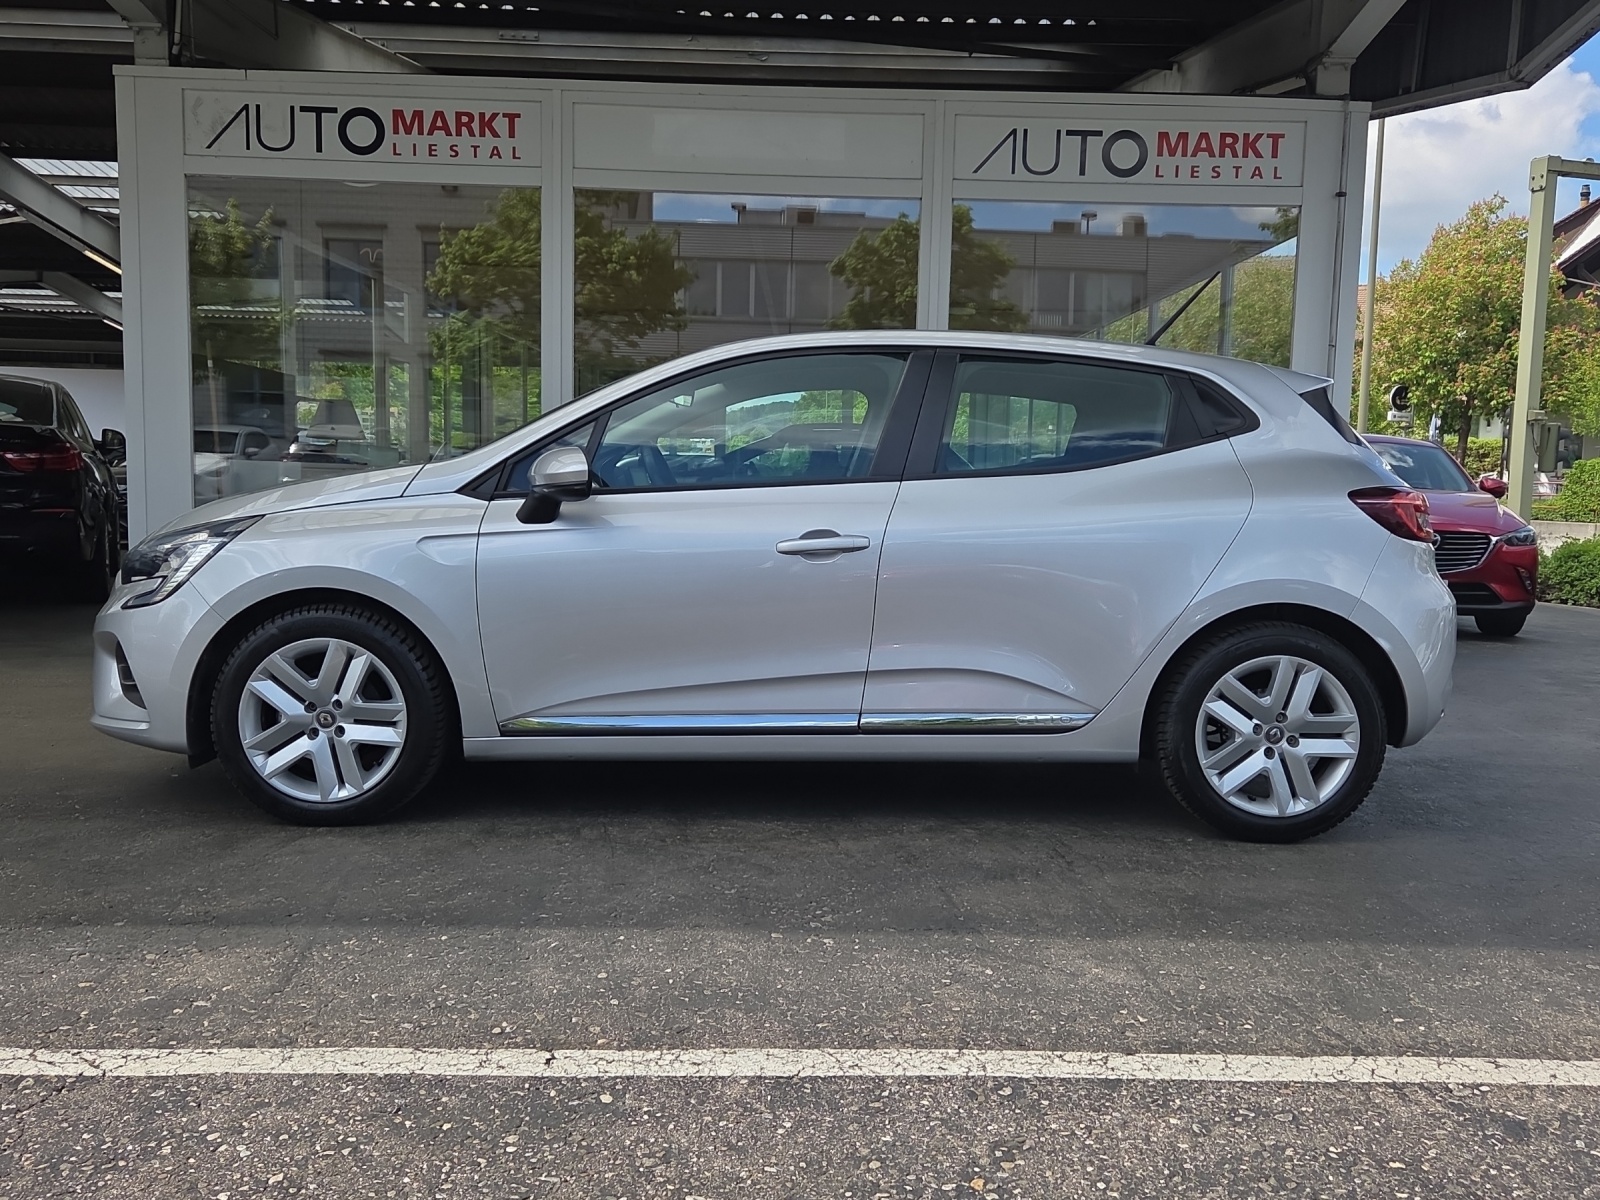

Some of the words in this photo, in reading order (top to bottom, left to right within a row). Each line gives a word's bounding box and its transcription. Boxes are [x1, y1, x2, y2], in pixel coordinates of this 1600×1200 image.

[205, 103, 386, 156] AUTO
[391, 109, 522, 139] MARKT
[392, 142, 522, 160] LIESTAL
[971, 127, 1149, 178] AUTO
[1156, 131, 1286, 160] MARKT
[1154, 164, 1283, 180] LIESTAL
[1016, 715, 1073, 726] CLIO
